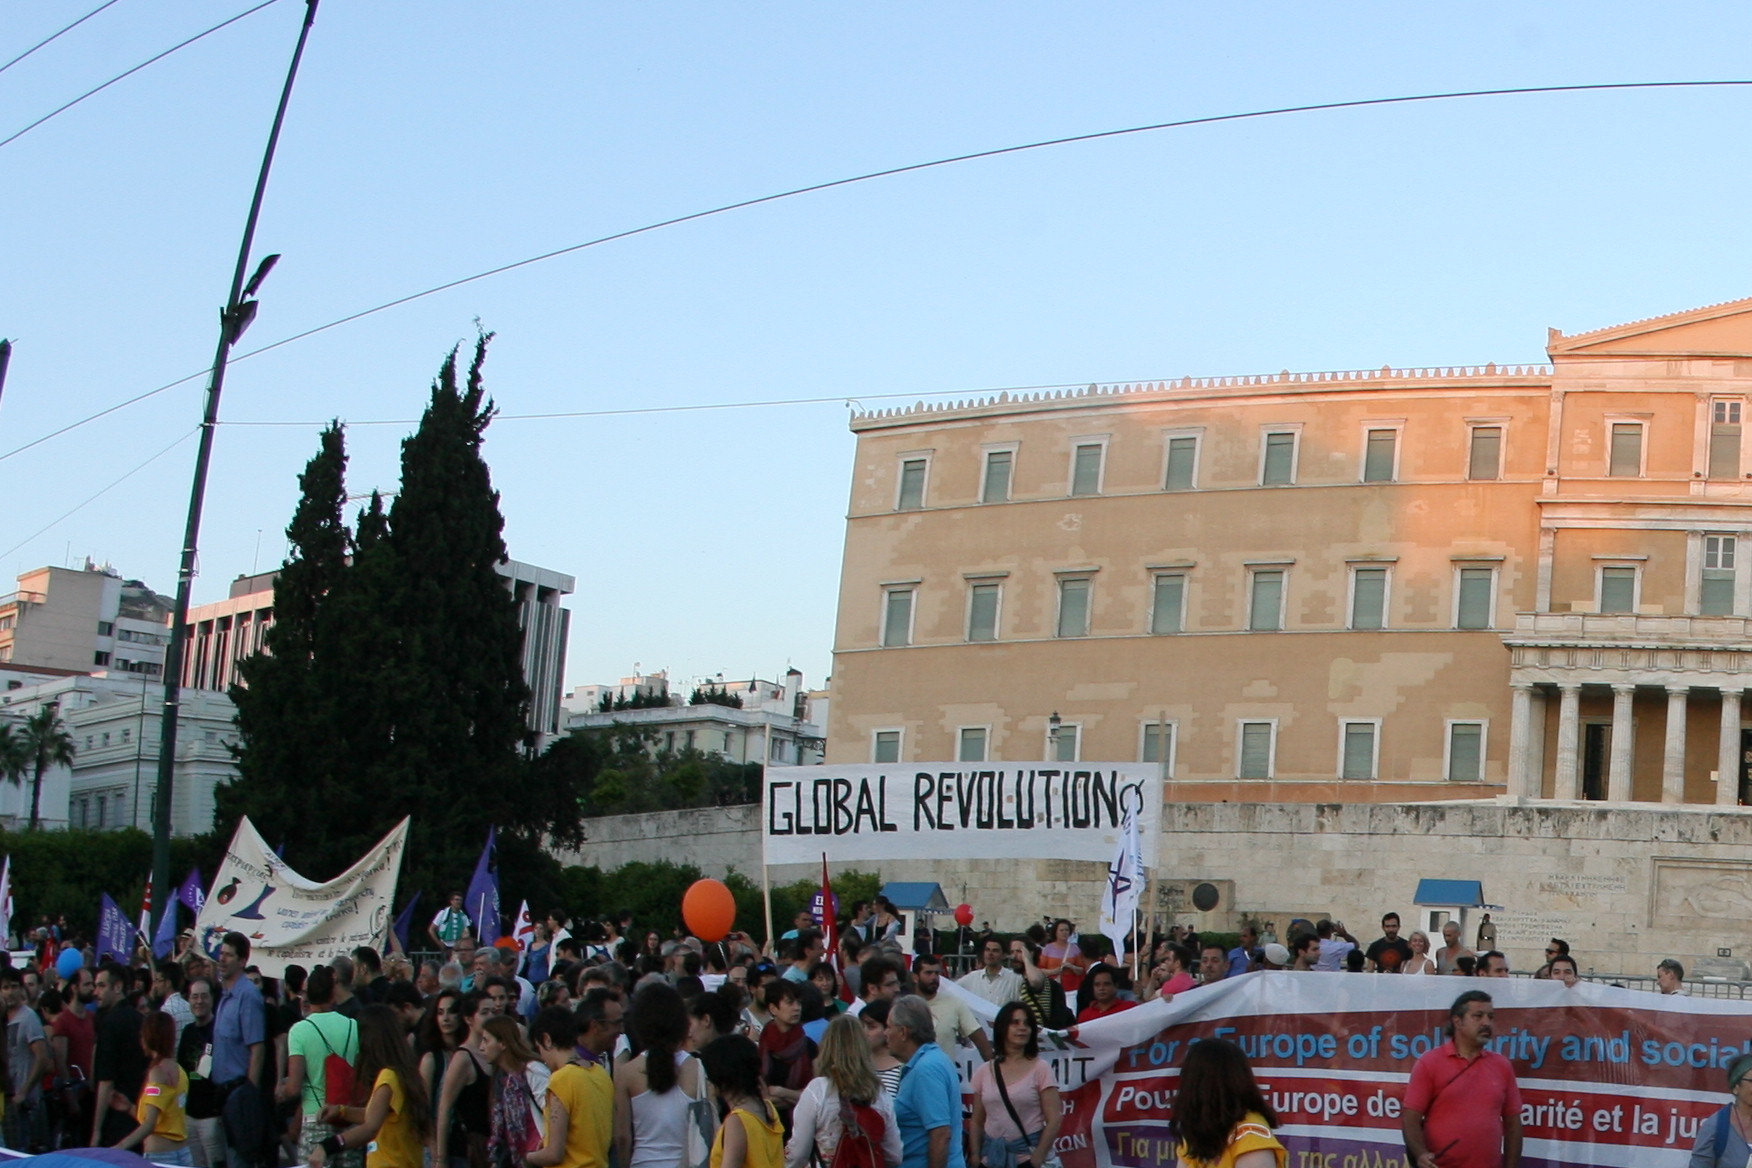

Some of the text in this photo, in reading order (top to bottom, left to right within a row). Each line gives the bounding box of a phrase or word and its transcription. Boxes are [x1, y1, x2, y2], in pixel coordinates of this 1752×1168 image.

[769, 774, 897, 836] GLOBAL
[1128, 1039, 1181, 1067] For
[1348, 1025, 1382, 1060] of
[1390, 1025, 1551, 1069] solrity
[1560, 1030, 1631, 1064] and
[1115, 1086, 1178, 1112] Pou
[1366, 1089, 1401, 1119] de
[1592, 1104, 1623, 1133] et
[1632, 1104, 1659, 1136] la
[1116, 1132, 1150, 1159] Για
